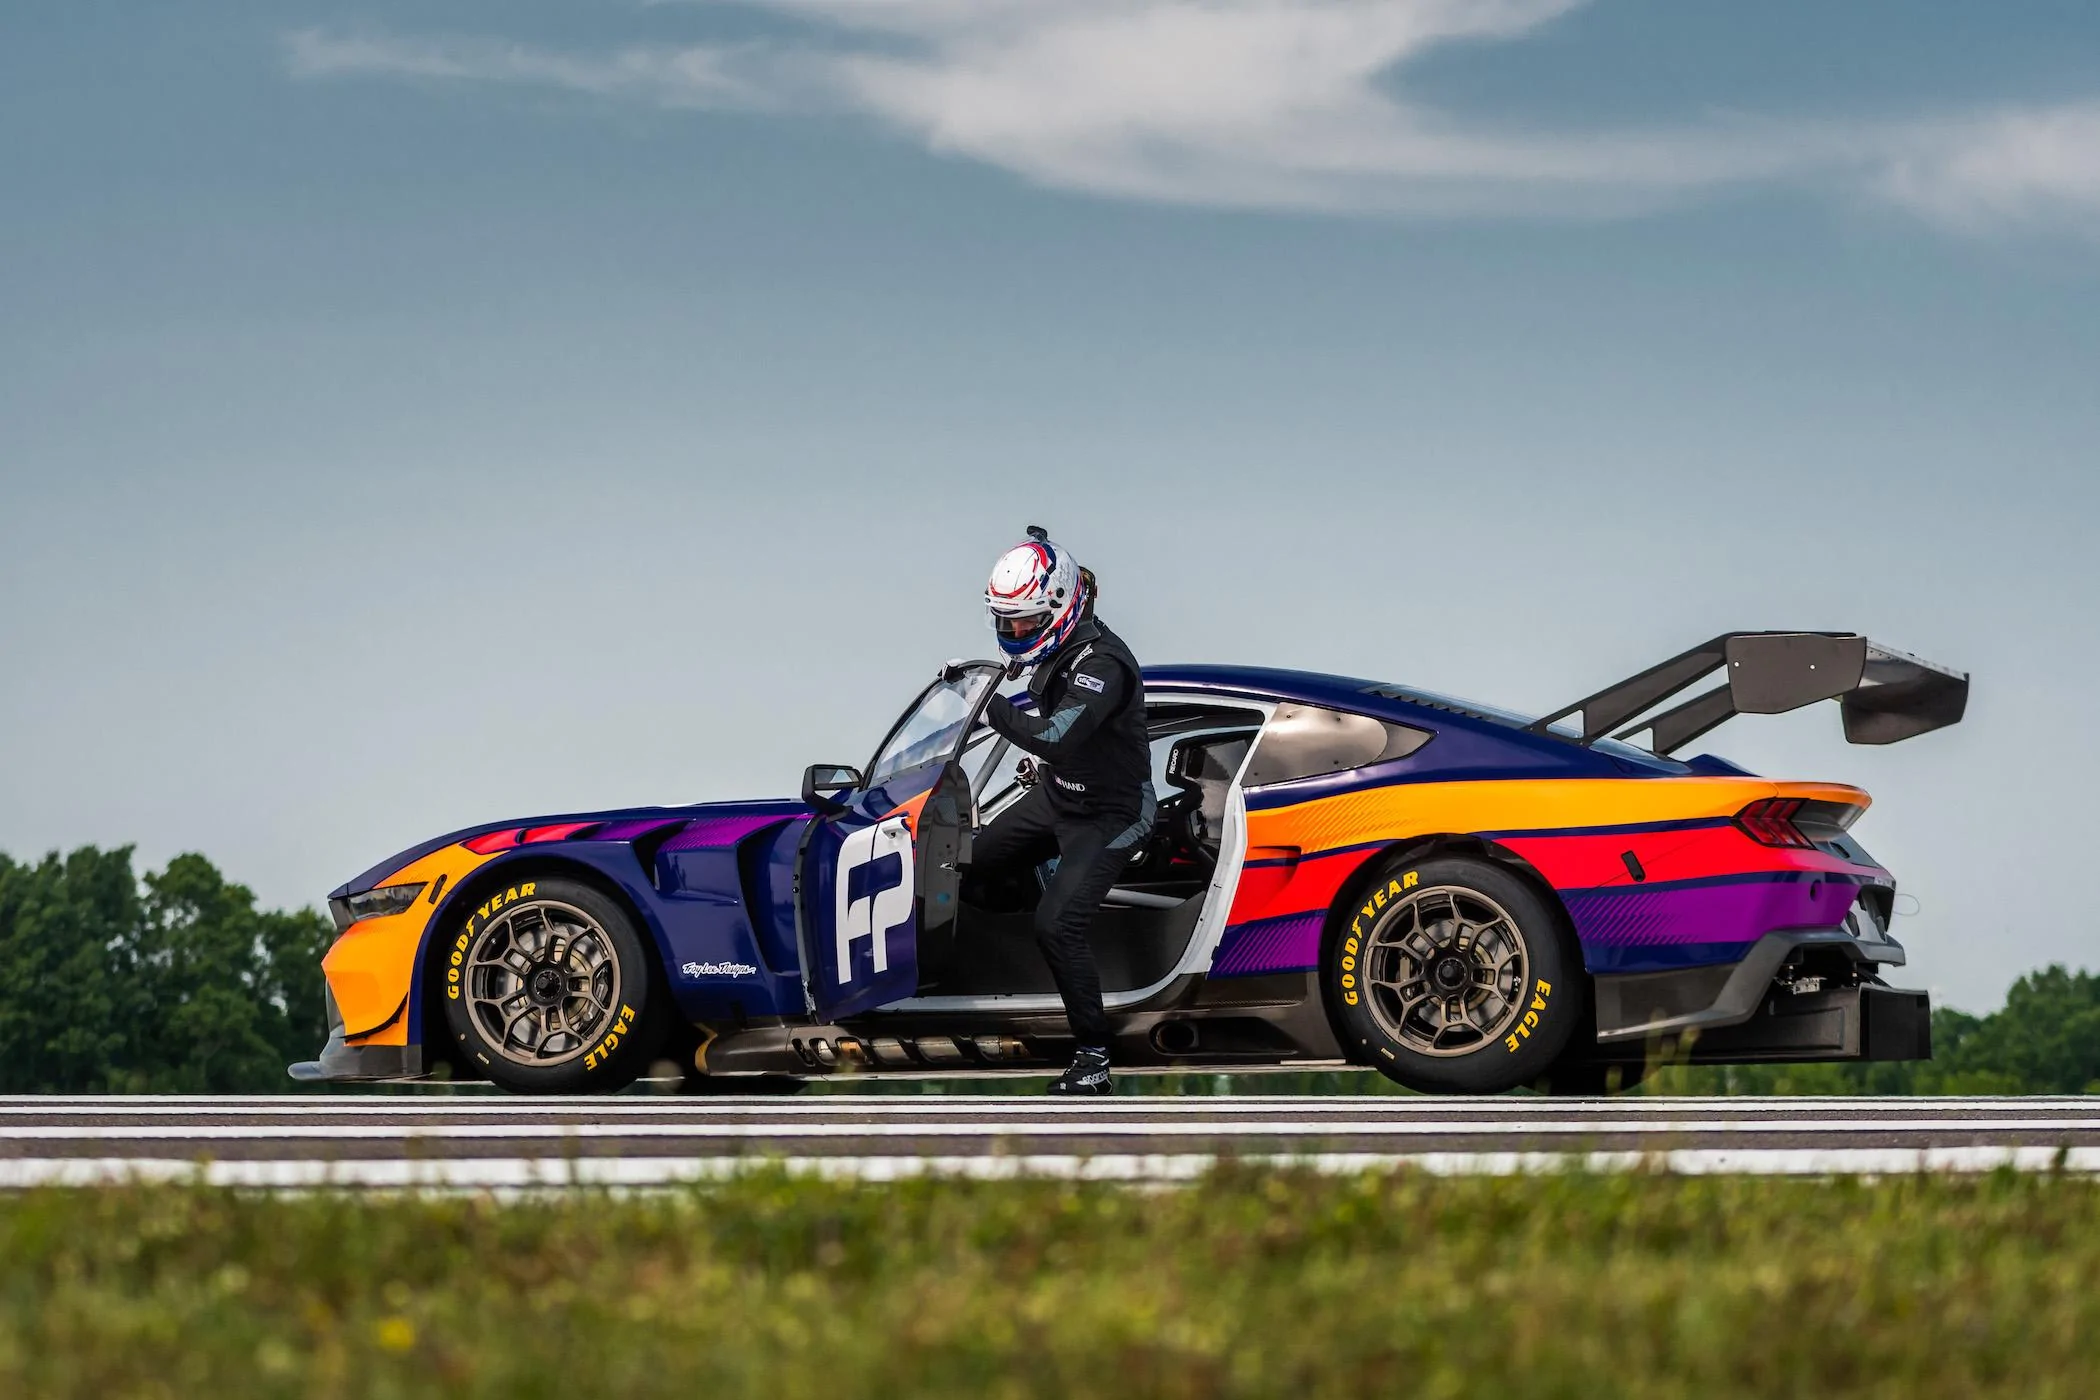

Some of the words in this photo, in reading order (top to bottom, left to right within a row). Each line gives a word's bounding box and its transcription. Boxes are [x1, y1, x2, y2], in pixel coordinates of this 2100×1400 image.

[1061, 780, 1086, 791] HAND
[1169, 748, 1179, 774] RECARO
[447, 882, 537, 1000] GOODYEAR
[682, 962, 702, 978] Troy
[1341, 871, 1420, 1006] GOODYEAR
[584, 1003, 636, 1071] EAGLE
[1504, 978, 1552, 1053] EAGLE
